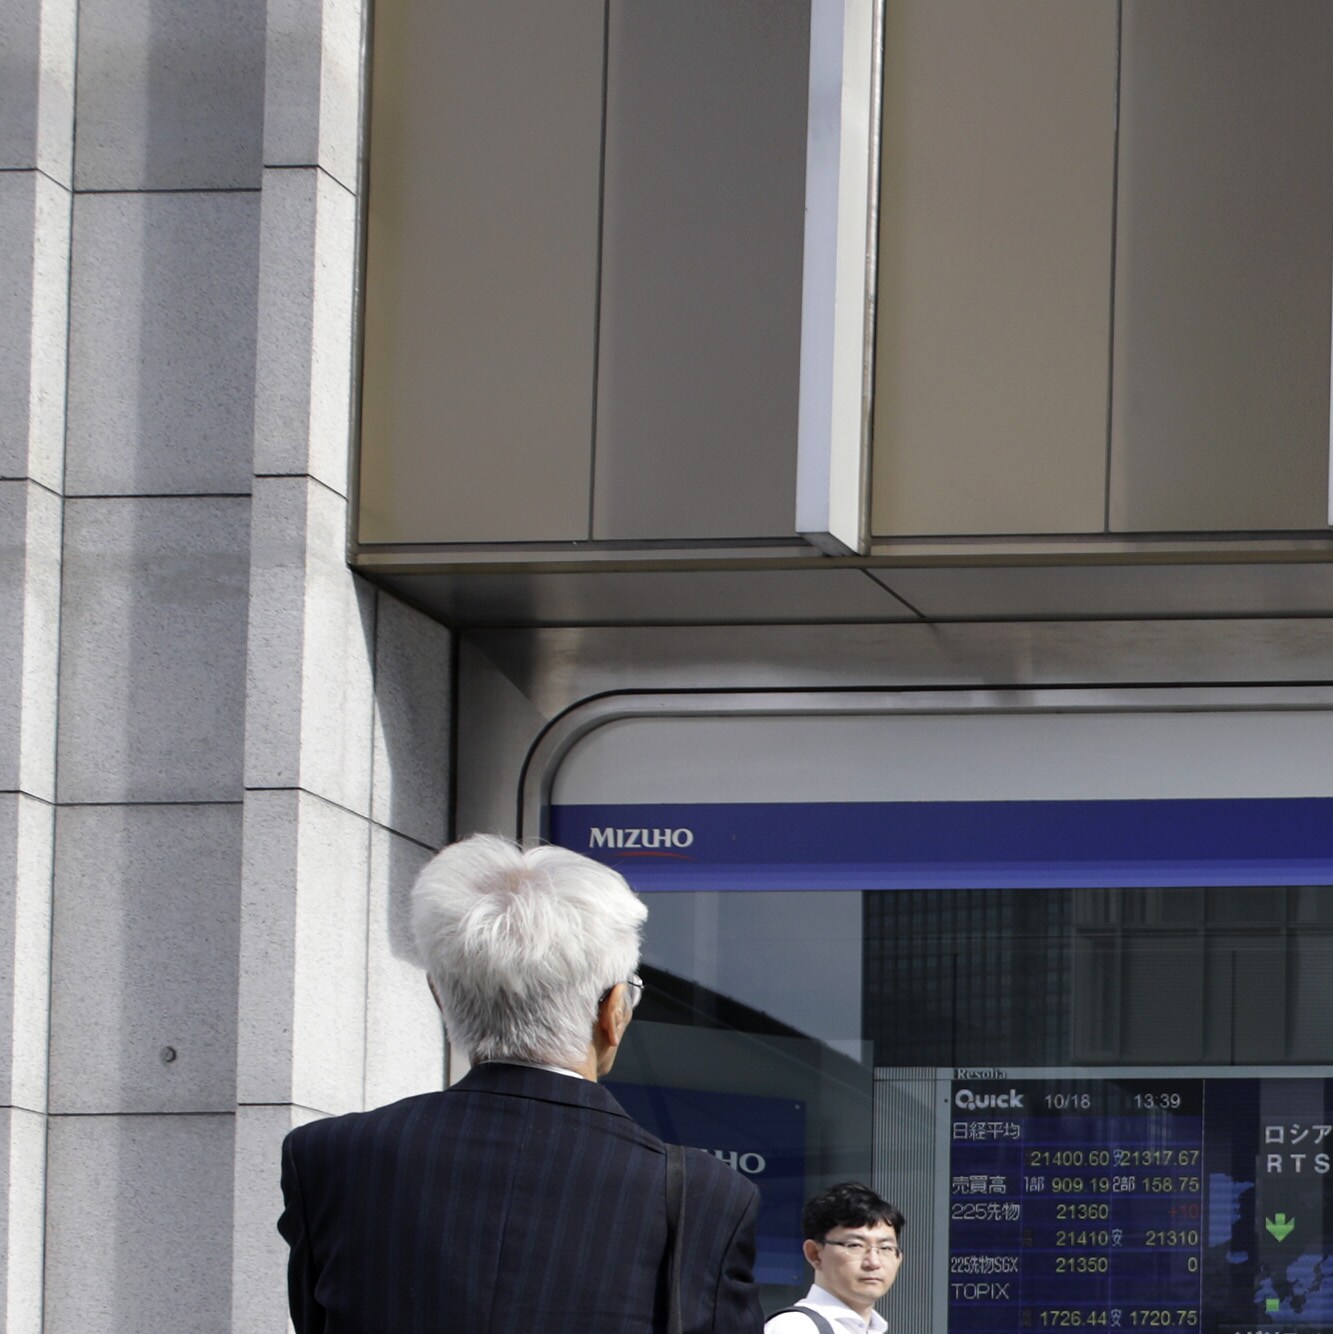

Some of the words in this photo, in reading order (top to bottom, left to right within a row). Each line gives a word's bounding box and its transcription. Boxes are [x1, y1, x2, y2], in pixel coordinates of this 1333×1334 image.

[589, 826, 694, 849] MIZUHO
[955, 1089, 1024, 1111] Quick
[1045, 1093, 1091, 1109] 10/18
[1134, 1093, 1181, 1109] 13:39
[952, 1122, 1021, 1141] 日経平均
[1265, 1124, 1333, 1144] ロシア
[1030, 1151, 1110, 1167] 21400.60
[1121, 1150, 1200, 1167] 21317.67
[1267, 1153, 1331, 1174] RTS
[952, 1175, 1007, 1195] 売買高
[1052, 1177, 1110, 1193] 909.19
[1142, 1177, 1200, 1193] 158.75
[951, 1202, 1021, 1221] 225先物
[1056, 1204, 1109, 1220] 21360
[1056, 1231, 1108, 1247] 21410
[1145, 1230, 1199, 1247] 21310
[1055, 1257, 1108, 1273] 21350
[1187, 1257, 1199, 1272] 0
[951, 1283, 1010, 1300] TOPIX
[1039, 1310, 1108, 1326] 1726.44
[1129, 1310, 1198, 1326] 1720.75
